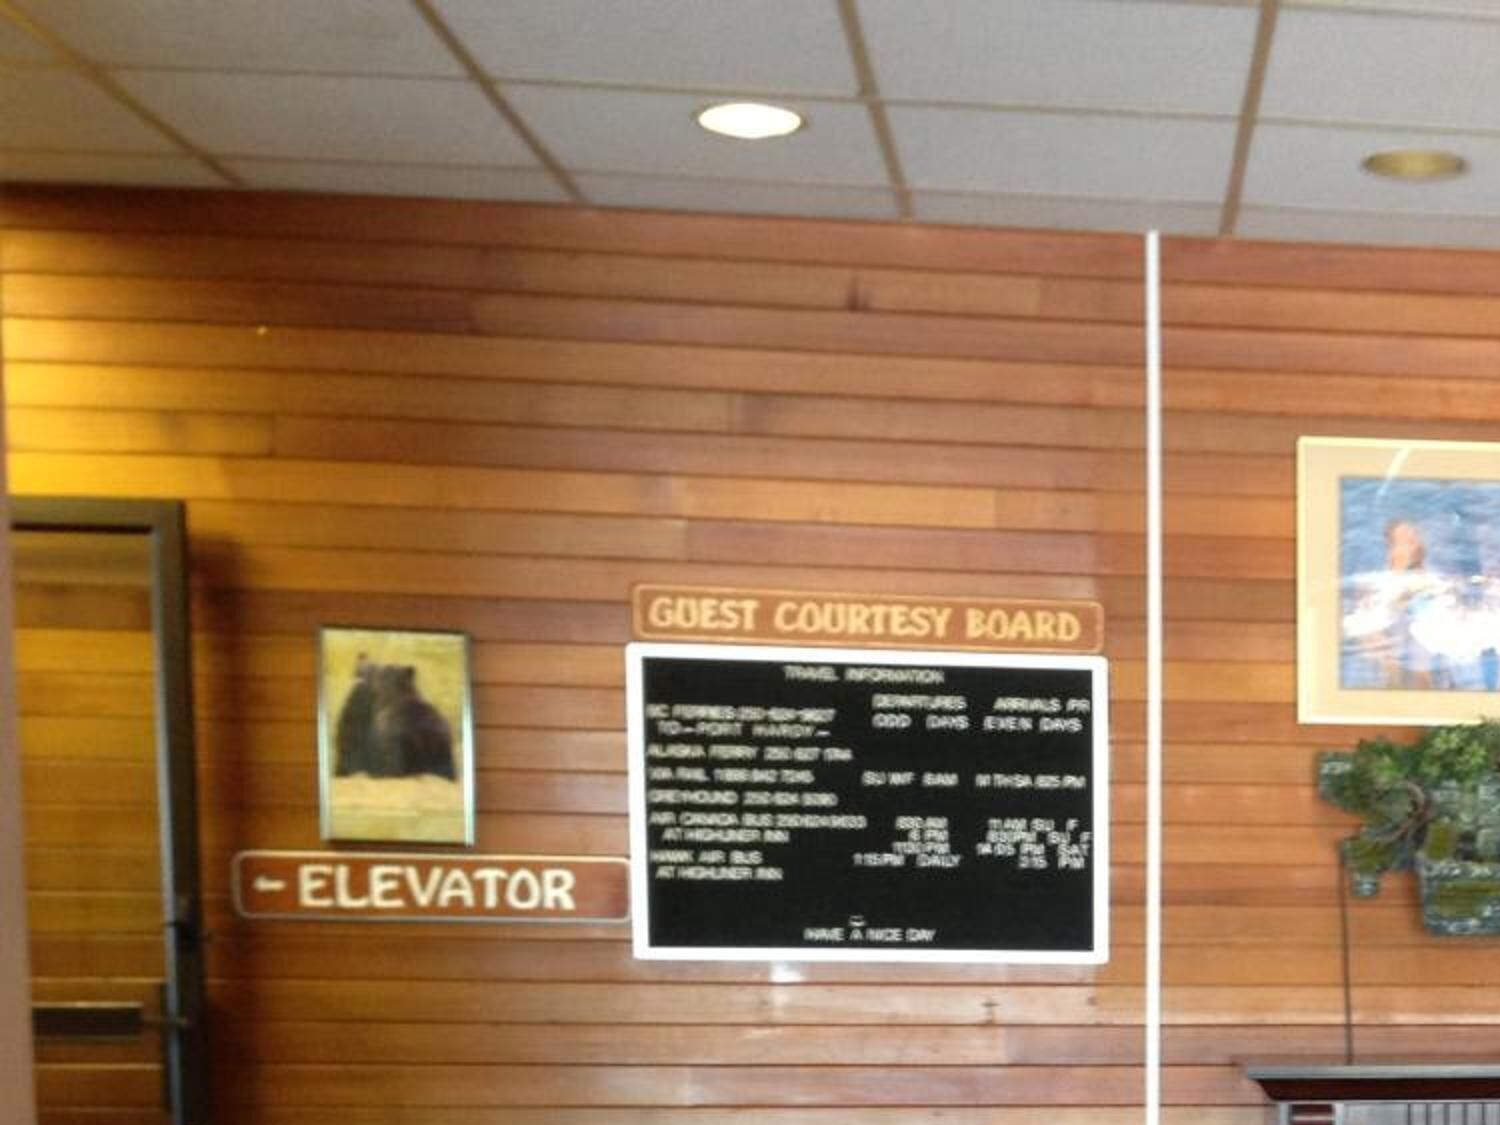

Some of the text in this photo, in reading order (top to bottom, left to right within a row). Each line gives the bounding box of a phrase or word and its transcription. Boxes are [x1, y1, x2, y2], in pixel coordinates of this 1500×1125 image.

[649, 597, 1080, 641] GUEST COURTESY BOARD
[784, 666, 944, 682] TRAVEL INFORMATION
[872, 694, 967, 709] DEPARTURES
[994, 697, 1061, 712] ARRIVALS
[872, 714, 969, 729] ODD DAYS
[984, 716, 1082, 732] EVEN DAYS
[647, 744, 704, 758] ALASKA
[679, 812, 738, 826] CANADA
[298, 864, 576, 910] ELEVATOR
[804, 928, 935, 942] HAVE A NICE DAY
